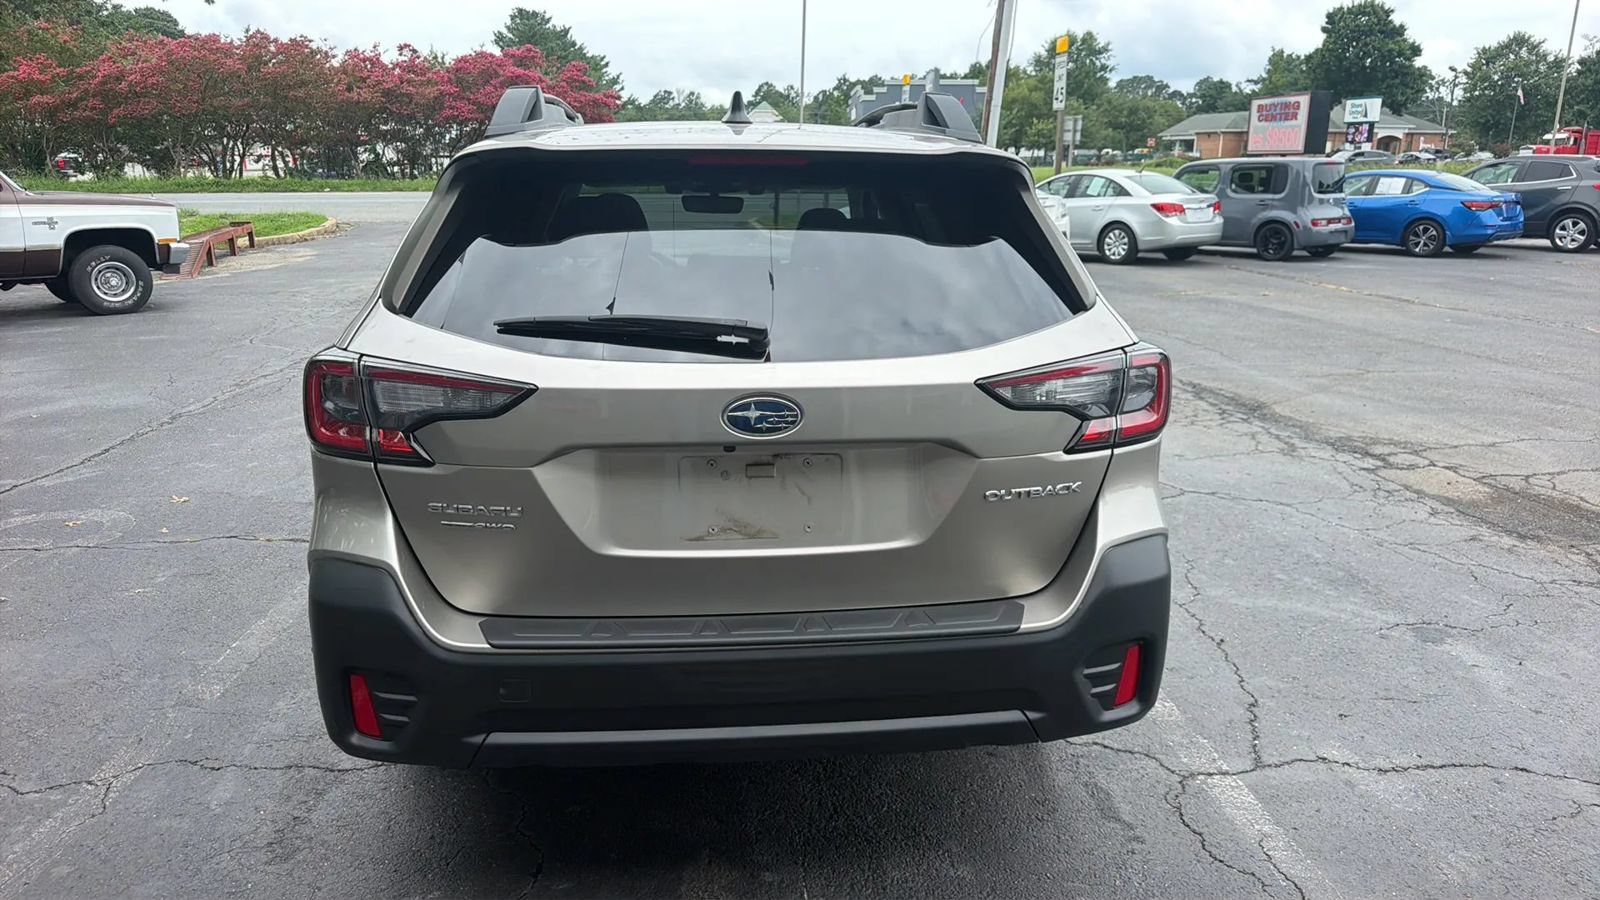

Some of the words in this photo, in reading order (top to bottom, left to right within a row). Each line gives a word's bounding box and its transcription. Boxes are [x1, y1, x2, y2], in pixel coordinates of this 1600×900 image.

[1054, 87, 1065, 104] 45
[1257, 101, 1300, 113] BUYING
[1257, 112, 1299, 123] CENTER
[86, 255, 111, 273] KELLY
[984, 481, 1082, 501] OUTBACK
[427, 502, 523, 517] SUBARU
